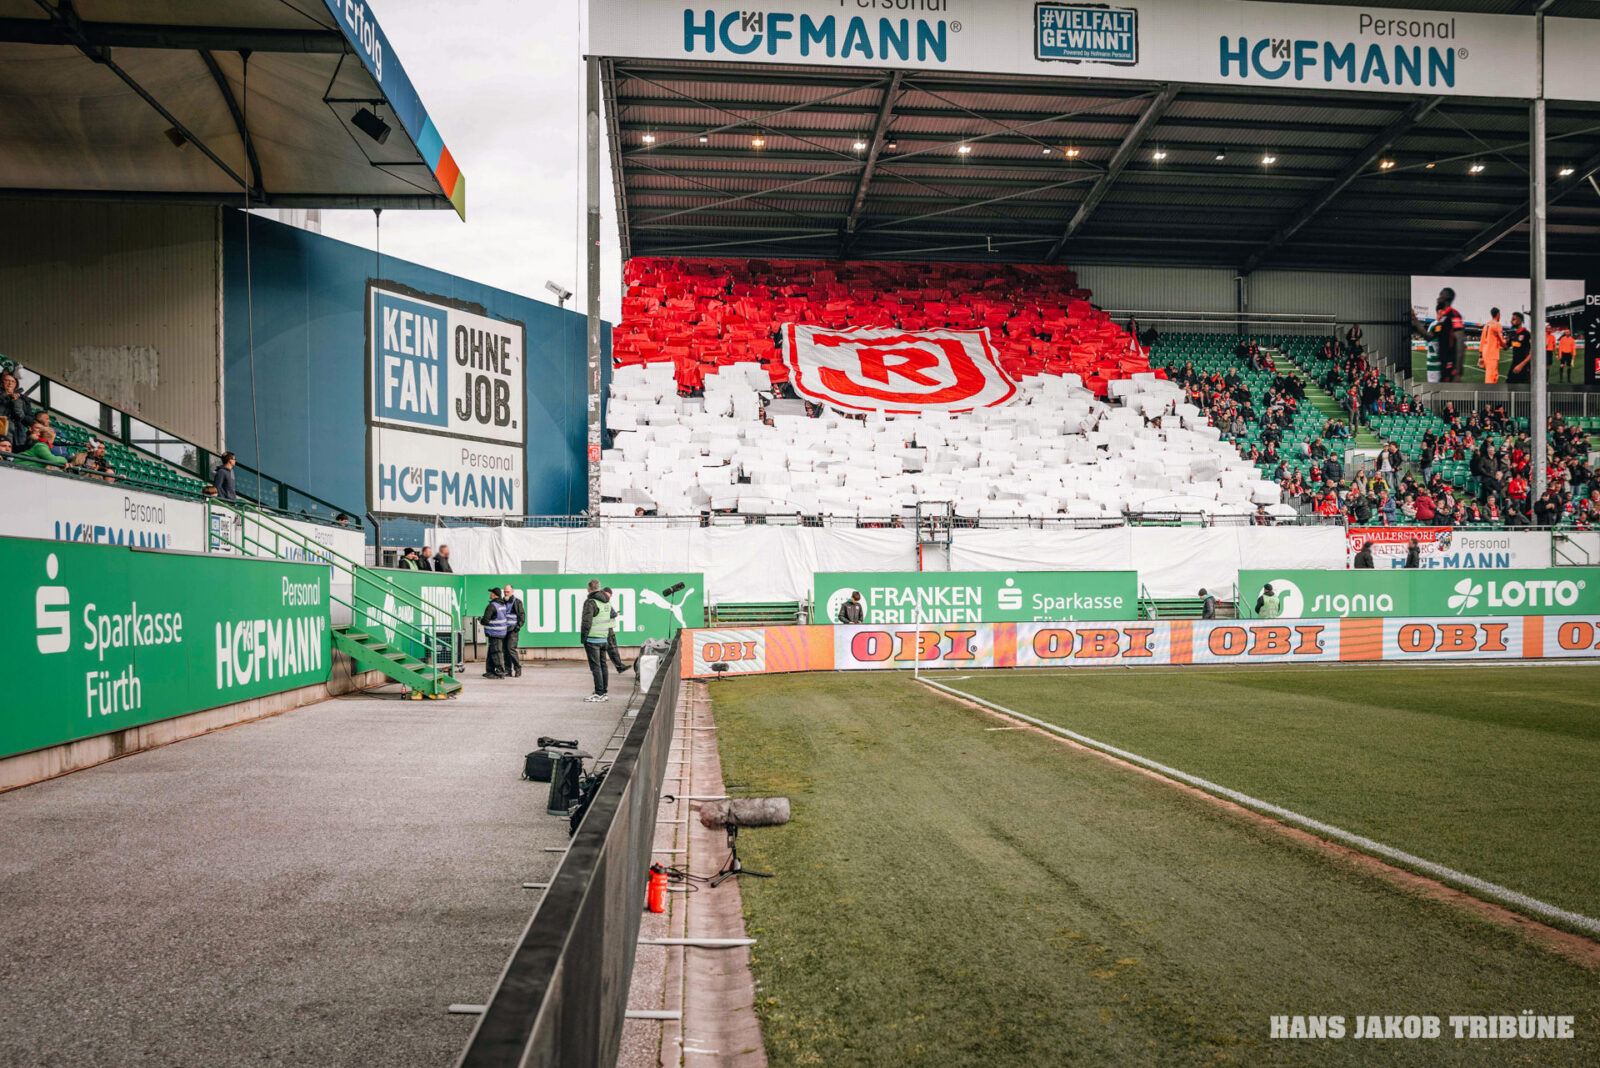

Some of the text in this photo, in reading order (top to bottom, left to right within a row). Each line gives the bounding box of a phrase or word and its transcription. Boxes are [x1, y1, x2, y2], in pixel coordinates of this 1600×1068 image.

[1041, 10, 1131, 31] #VIELFALT
[1360, 14, 1455, 39] Personal
[684, 9, 946, 62] HOFMANN
[1042, 29, 1131, 51] GEWINNT
[1219, 35, 1455, 88] HOFMANN
[383, 306, 438, 361] KEIN
[455, 324, 512, 376] OHNE
[384, 355, 438, 416] FAN
[456, 372, 518, 429] JOB.
[461, 448, 513, 471] Personal
[379, 463, 513, 511] HOFMANN
[124, 496, 166, 525] Personal
[1366, 531, 1435, 541] MALLERSDORF
[1461, 537, 1510, 550] Personal
[282, 576, 321, 606] Personal
[870, 586, 982, 606] FRANKEN
[1032, 593, 1123, 614] Sparkasse
[1311, 593, 1393, 618] signia
[1488, 580, 1579, 607] LOTTO
[83, 600, 183, 661] Sparkasse
[1033, 628, 1154, 659] OBI
[1208, 625, 1325, 656] OBI
[1397, 623, 1508, 652] OBI
[1558, 621, 1600, 650] O
[216, 616, 321, 690] HOFMANN
[702, 641, 757, 662] OBI
[851, 630, 976, 662] OBI
[86, 664, 142, 719] Fürth
